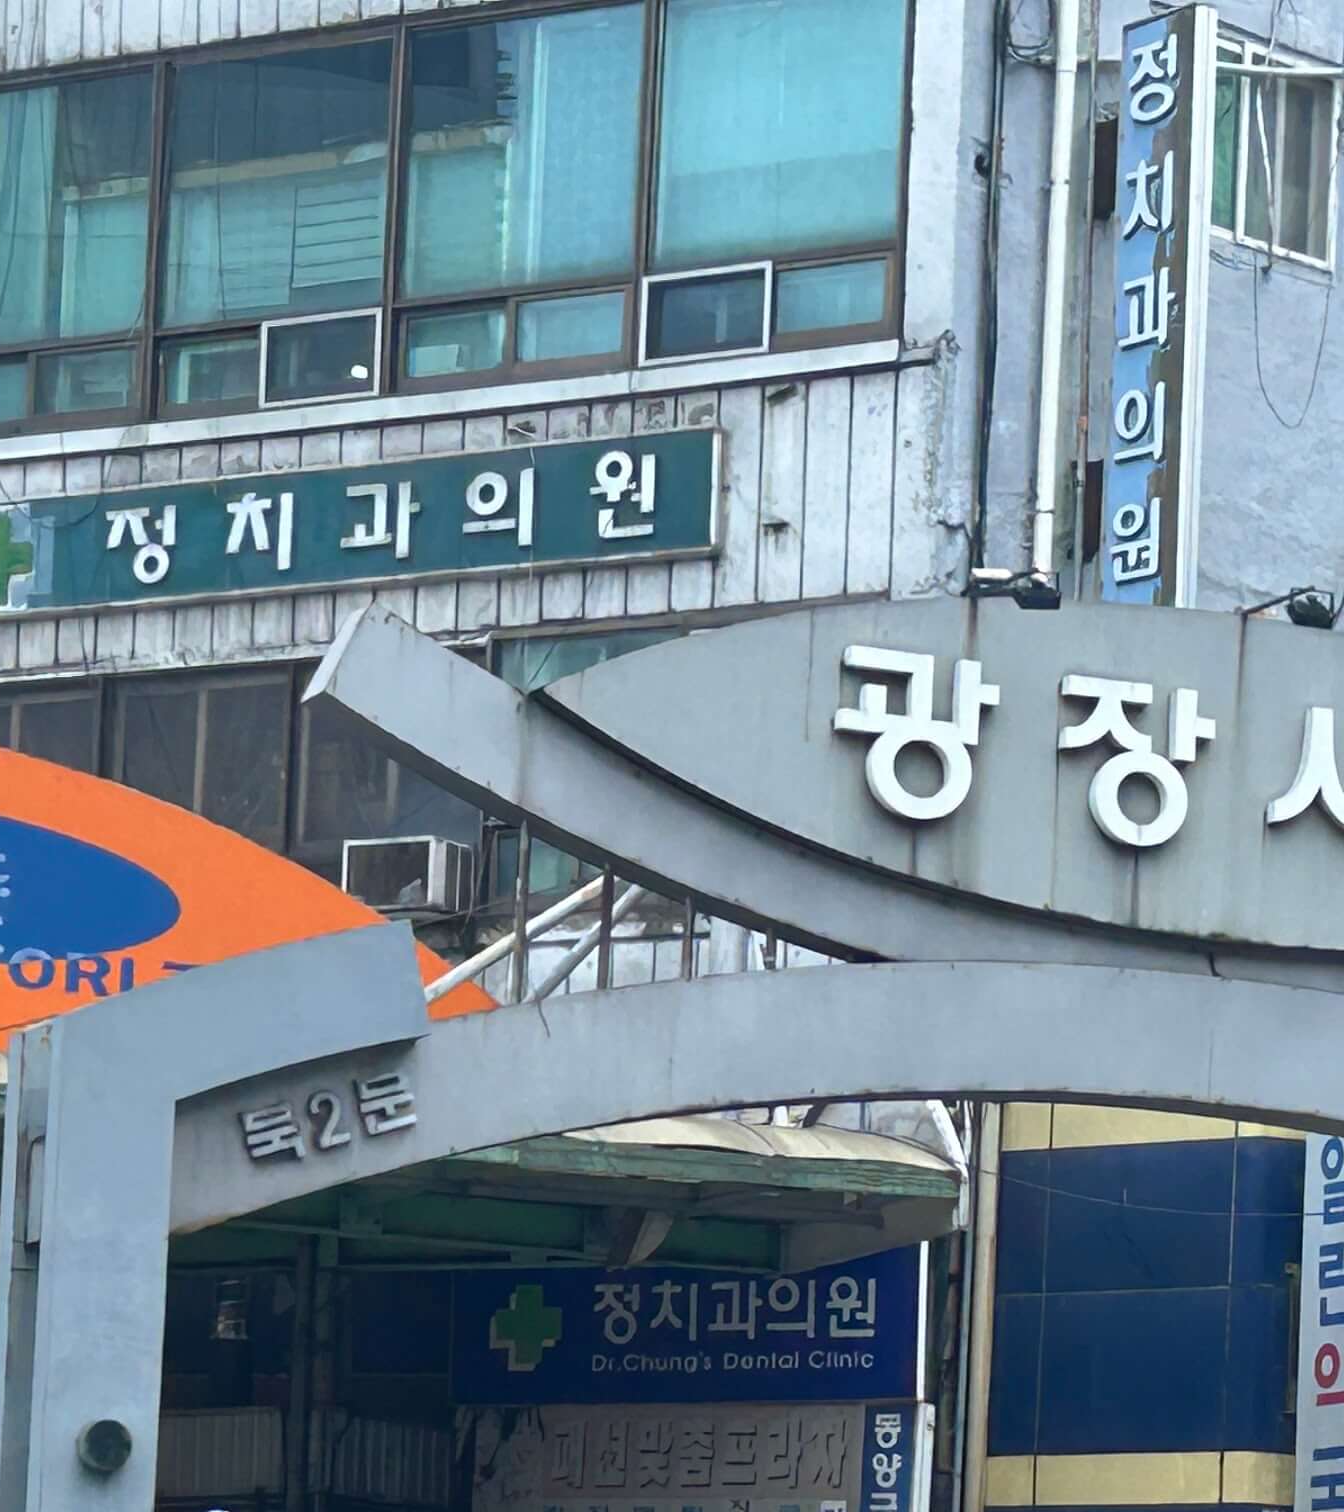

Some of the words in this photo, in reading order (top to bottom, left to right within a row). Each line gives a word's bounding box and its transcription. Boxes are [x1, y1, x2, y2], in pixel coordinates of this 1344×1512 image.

[1111, 33, 1180, 584] 정치과의원
[105, 448, 659, 586] 정치과의원
[238, 1072, 417, 1161] 북2문
[592, 1276, 878, 1345] 정치과의원
[723, 1350, 800, 1370] Dental
[808, 1349, 874, 1369] Clinic
